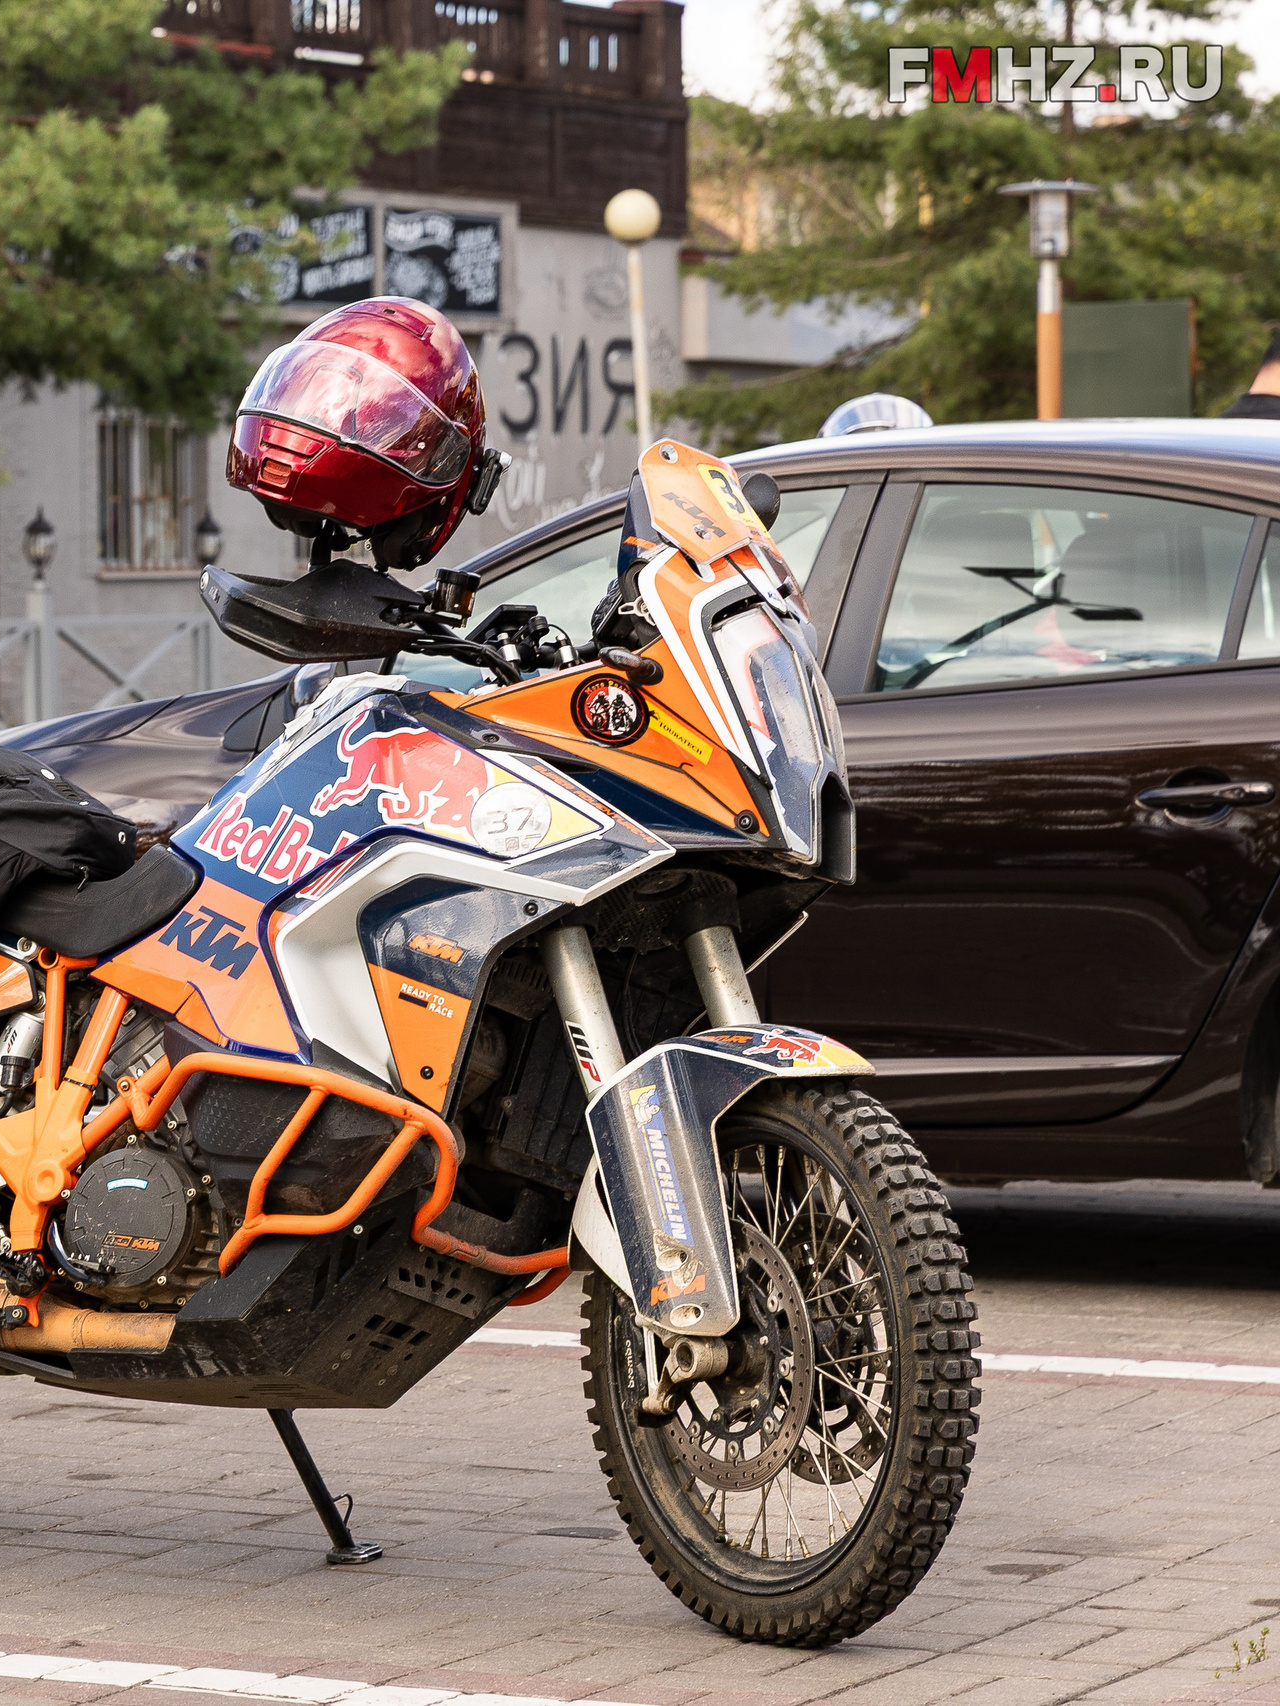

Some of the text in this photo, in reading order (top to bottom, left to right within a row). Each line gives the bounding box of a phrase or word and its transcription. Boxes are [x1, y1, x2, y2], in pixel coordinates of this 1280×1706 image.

[658, 721, 703, 756] TOURATECH
[196, 793, 292, 874] Red
[486, 806, 533, 834] 37
[158, 905, 259, 981] KTM
[408, 933, 465, 965] KTM
[400, 983, 446, 1006] READY TO
[428, 1003, 454, 1019] RACE
[567, 1022, 602, 1083] WP
[646, 1127, 688, 1242] MICHELIN
[131, 1237, 161, 1252] KTM
[626, 1338, 636, 1390] brembo
